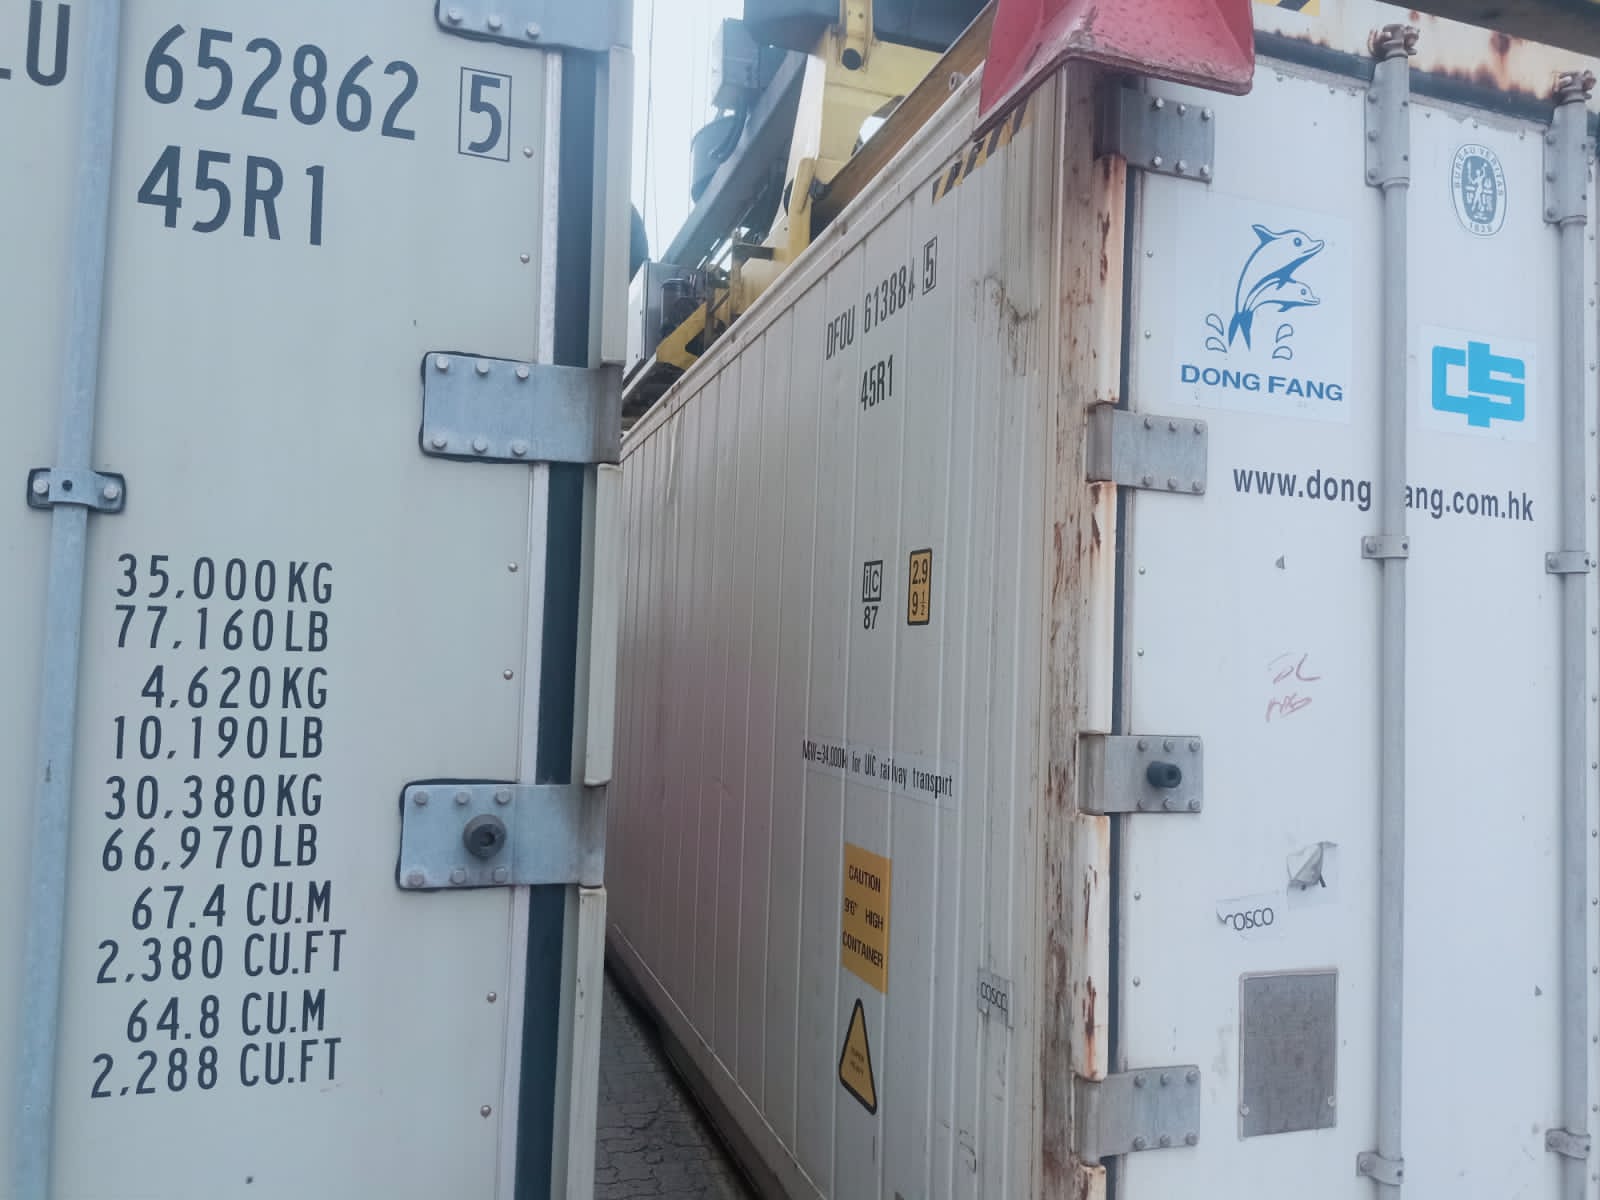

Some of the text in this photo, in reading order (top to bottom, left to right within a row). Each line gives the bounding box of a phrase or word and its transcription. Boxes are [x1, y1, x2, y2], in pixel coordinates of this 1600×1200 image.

[144, 23, 419, 140] 652862
[466, 73, 503, 154] 5
[137, 145, 325, 246] 45R1
[826, 240, 936, 361] DFOU 613884 5
[861, 354, 893, 411] 45R1
[1181, 364, 1343, 402] DONG FANG
[1233, 468, 1534, 521] www.dongang.com.hk
[912, 558, 929, 584] 2.9
[863, 605, 879, 630] 87
[852, 751, 861, 773] for
[865, 753, 876, 777] UIC
[848, 865, 881, 893] CAUTION
[131, 880, 332, 930] 67.4 CU.M
[865, 908, 883, 932] HIGH
[96, 929, 347, 984] 2,380 CU.FT
[842, 929, 883, 969] CONTAINER
[127, 988, 326, 1043] 64.8 CU.M
[90, 1037, 342, 1098] 2,288 CU.FT
